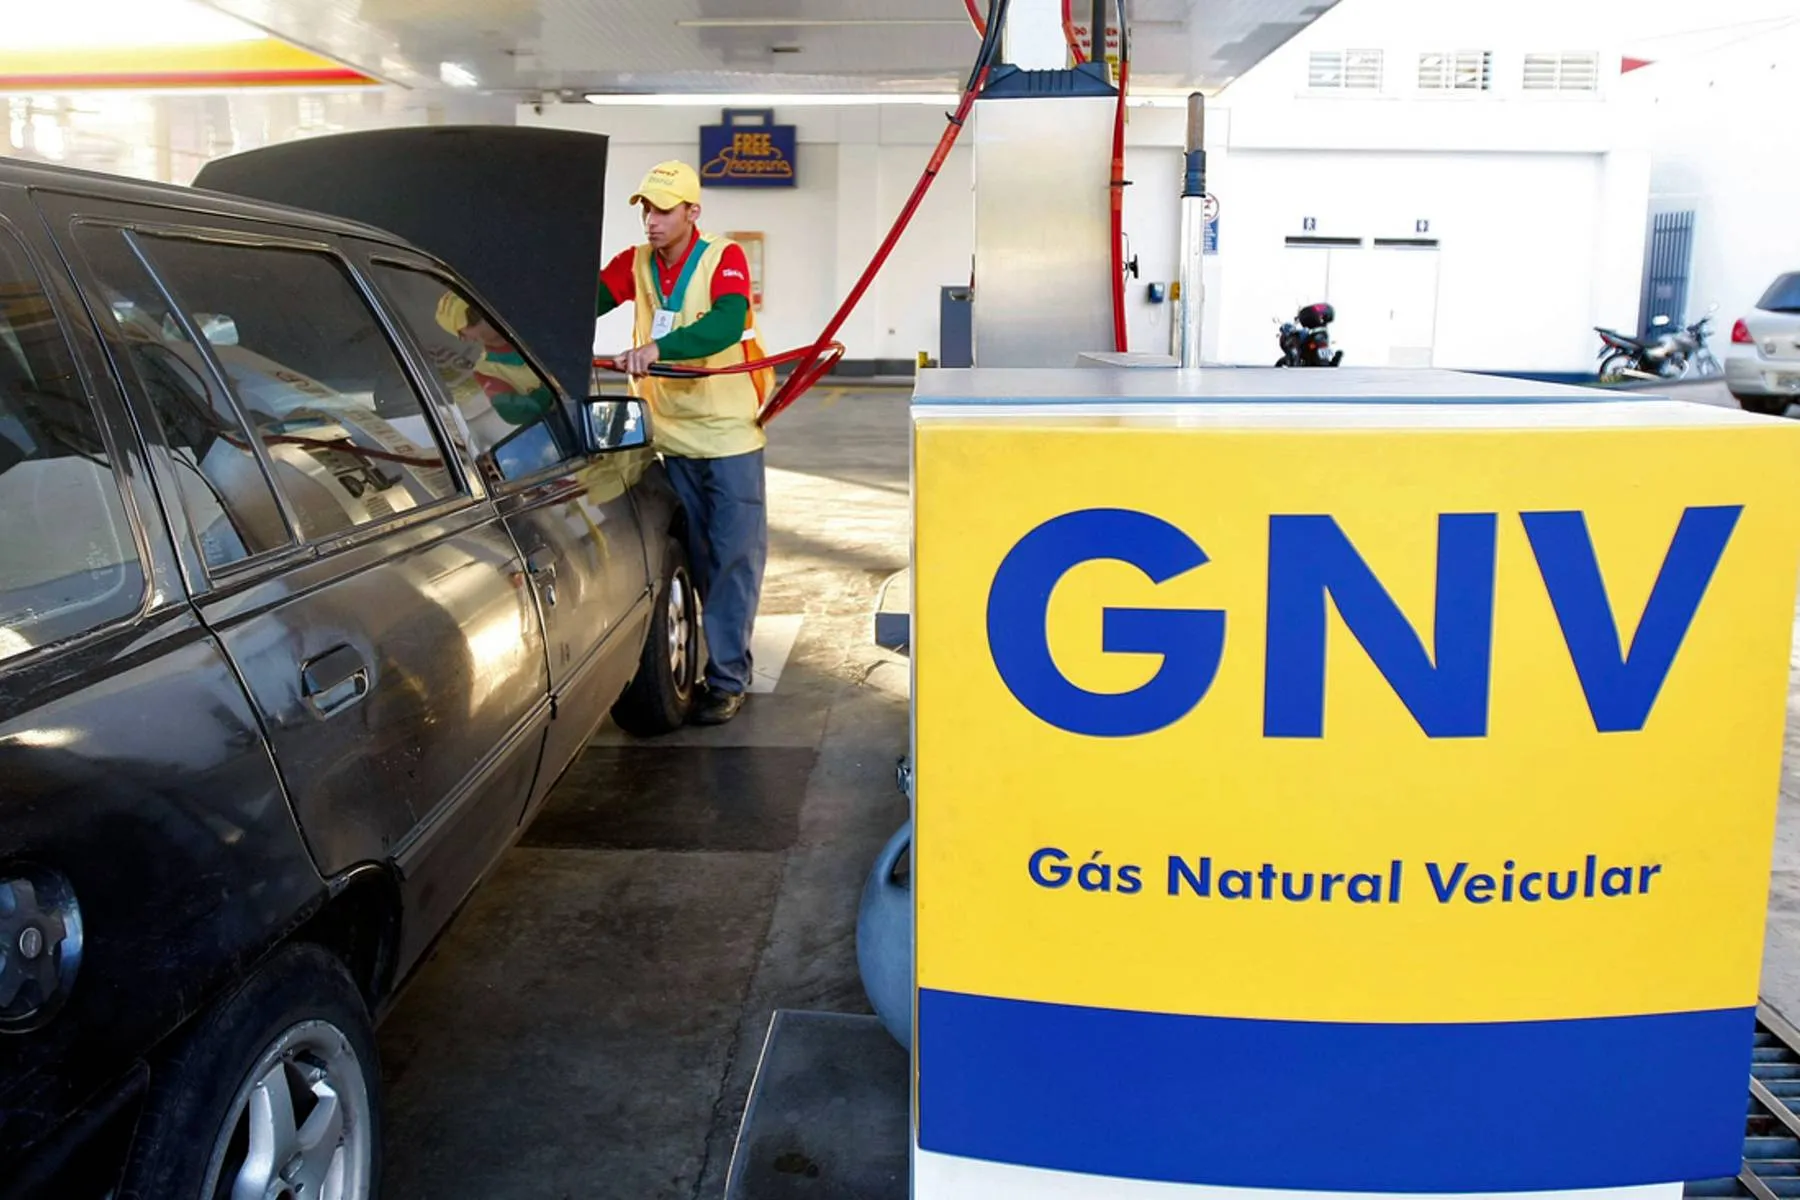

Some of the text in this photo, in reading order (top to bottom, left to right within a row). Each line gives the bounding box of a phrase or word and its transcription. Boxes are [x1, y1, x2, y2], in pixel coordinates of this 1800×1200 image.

[702, 146, 792, 177] Shopping
[733, 132, 771, 156] FREE
[987, 504, 1744, 739] GNV
[1028, 847, 1662, 904] Gás Natural Veicular
